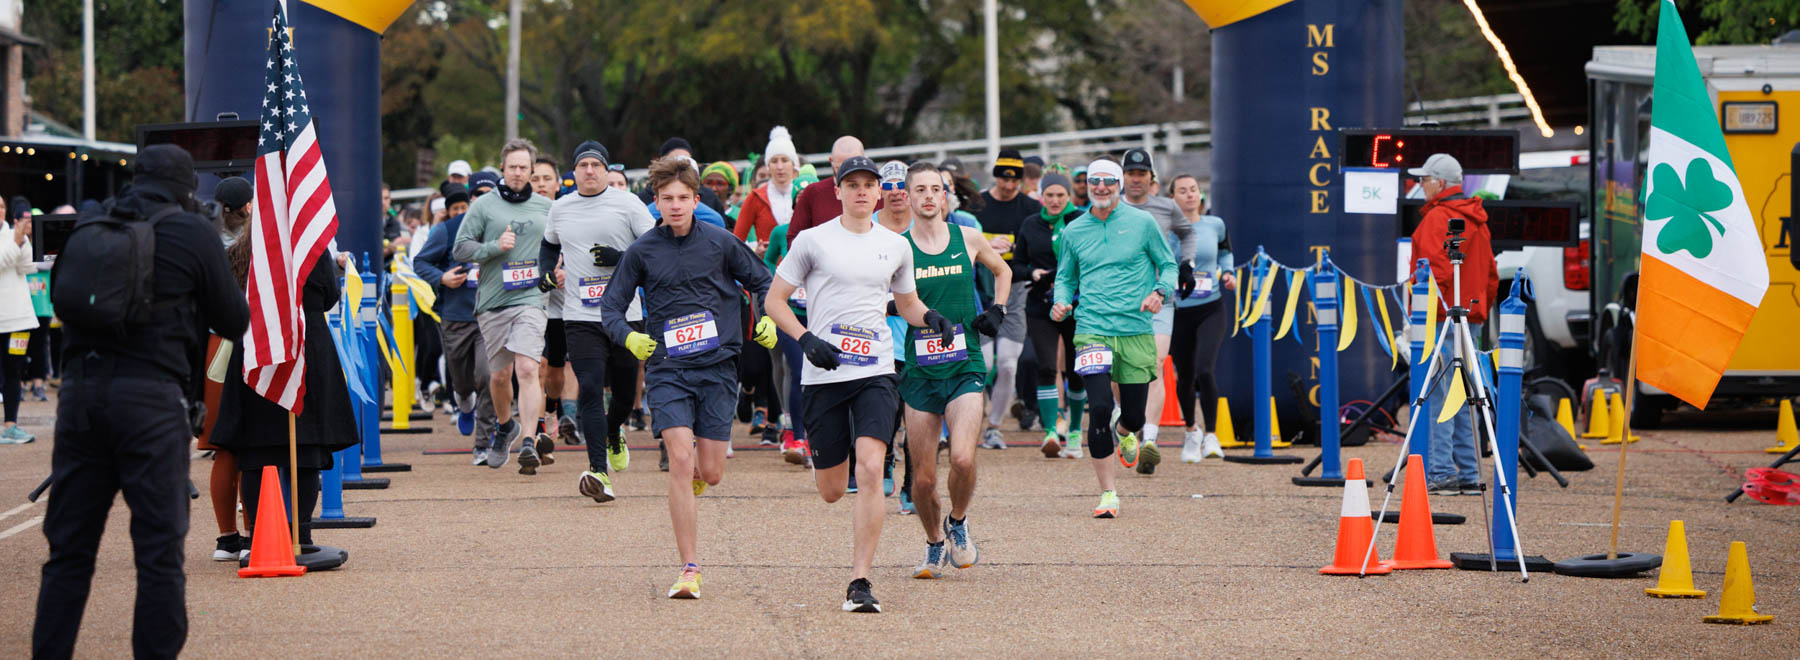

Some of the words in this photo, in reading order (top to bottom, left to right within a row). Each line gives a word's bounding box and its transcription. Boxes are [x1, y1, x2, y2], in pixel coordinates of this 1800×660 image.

[1306, 24, 1335, 76] MS
[1309, 106, 1332, 214] RACE
[1362, 186, 1382, 200] 5K
[512, 268, 533, 281] 614
[915, 264, 962, 280] Belhaven
[588, 286, 608, 298] 62
[676, 324, 703, 344] 627
[841, 337, 871, 355] 626
[1080, 352, 1104, 367] 619
